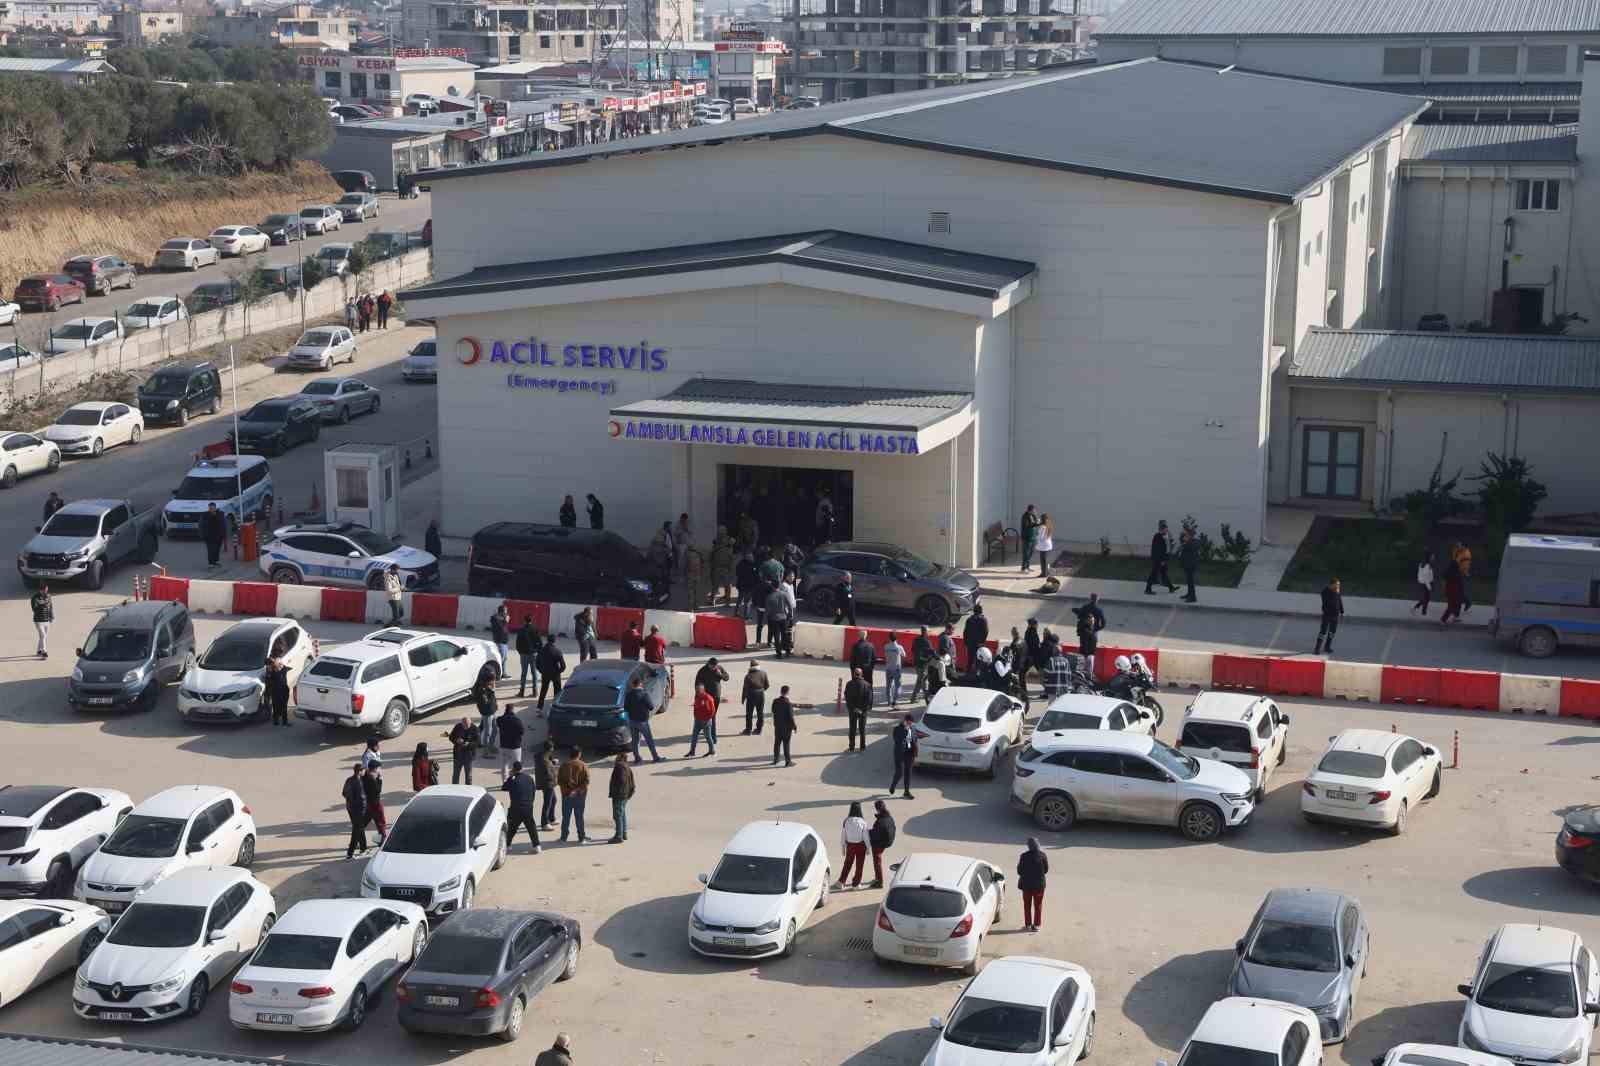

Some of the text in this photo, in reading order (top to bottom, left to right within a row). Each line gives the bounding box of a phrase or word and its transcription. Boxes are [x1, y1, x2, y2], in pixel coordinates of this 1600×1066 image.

[356, 58, 396, 70] KEBAP
[489, 336, 667, 372] ACİL SERVİS
[507, 374, 617, 397] (Emergency)
[625, 421, 919, 454] AMBULANSLA GELEN ACİL HASTA
